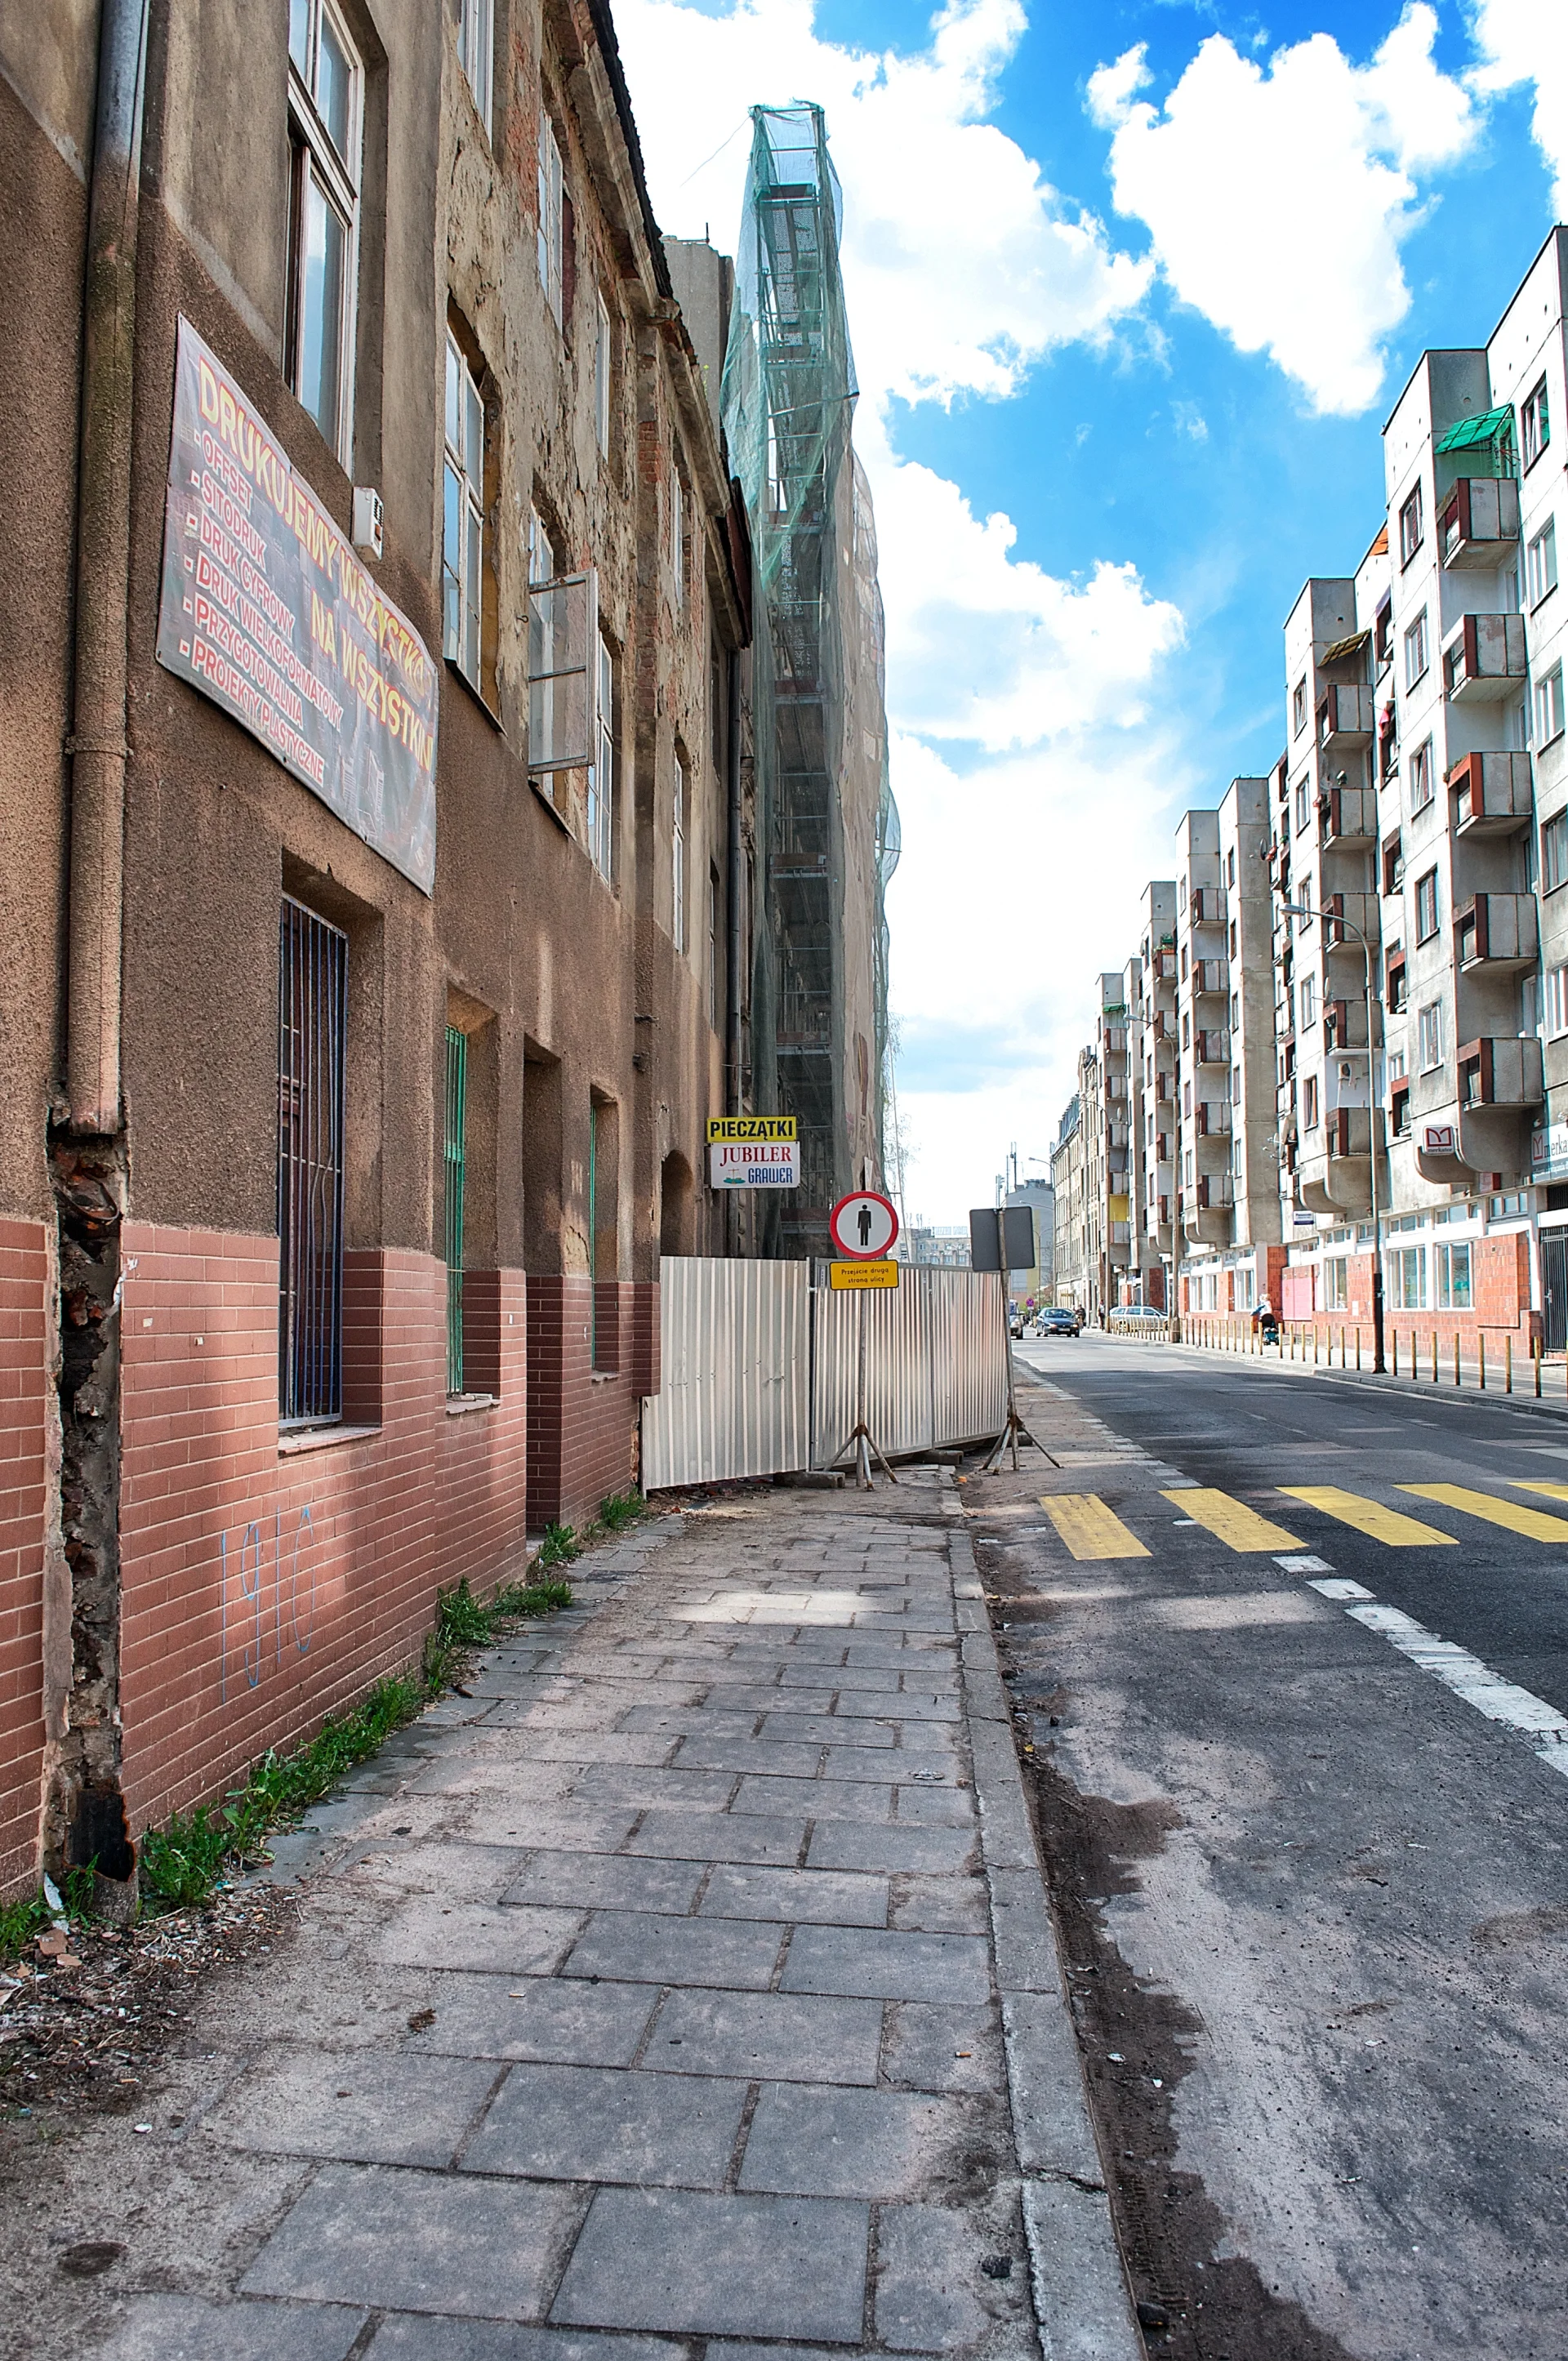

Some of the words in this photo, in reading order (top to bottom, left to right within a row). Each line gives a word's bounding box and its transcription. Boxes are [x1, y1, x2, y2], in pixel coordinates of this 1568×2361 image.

[200, 354, 339, 580] DRUKUJEMY
[202, 431, 252, 515] OFFSET
[202, 471, 267, 571] SITODRUK
[201, 511, 240, 578] DRUK
[241, 557, 295, 641] CYFROWY
[195, 592, 303, 730] PRZYGOTOWALNIA
[197, 550, 240, 621] DRUK
[240, 597, 342, 732] WIELKOFORMATOWY
[311, 587, 337, 667] NA
[192, 635, 259, 719] PROJEKTY
[261, 701, 324, 786] PLASTYCZNE
[710, 1120, 793, 1140] PIECZĄTKI
[719, 1147, 792, 1166] JUBILER
[748, 1168, 792, 1183] GRAWER
[1544, 1134, 1568, 1158] merka
